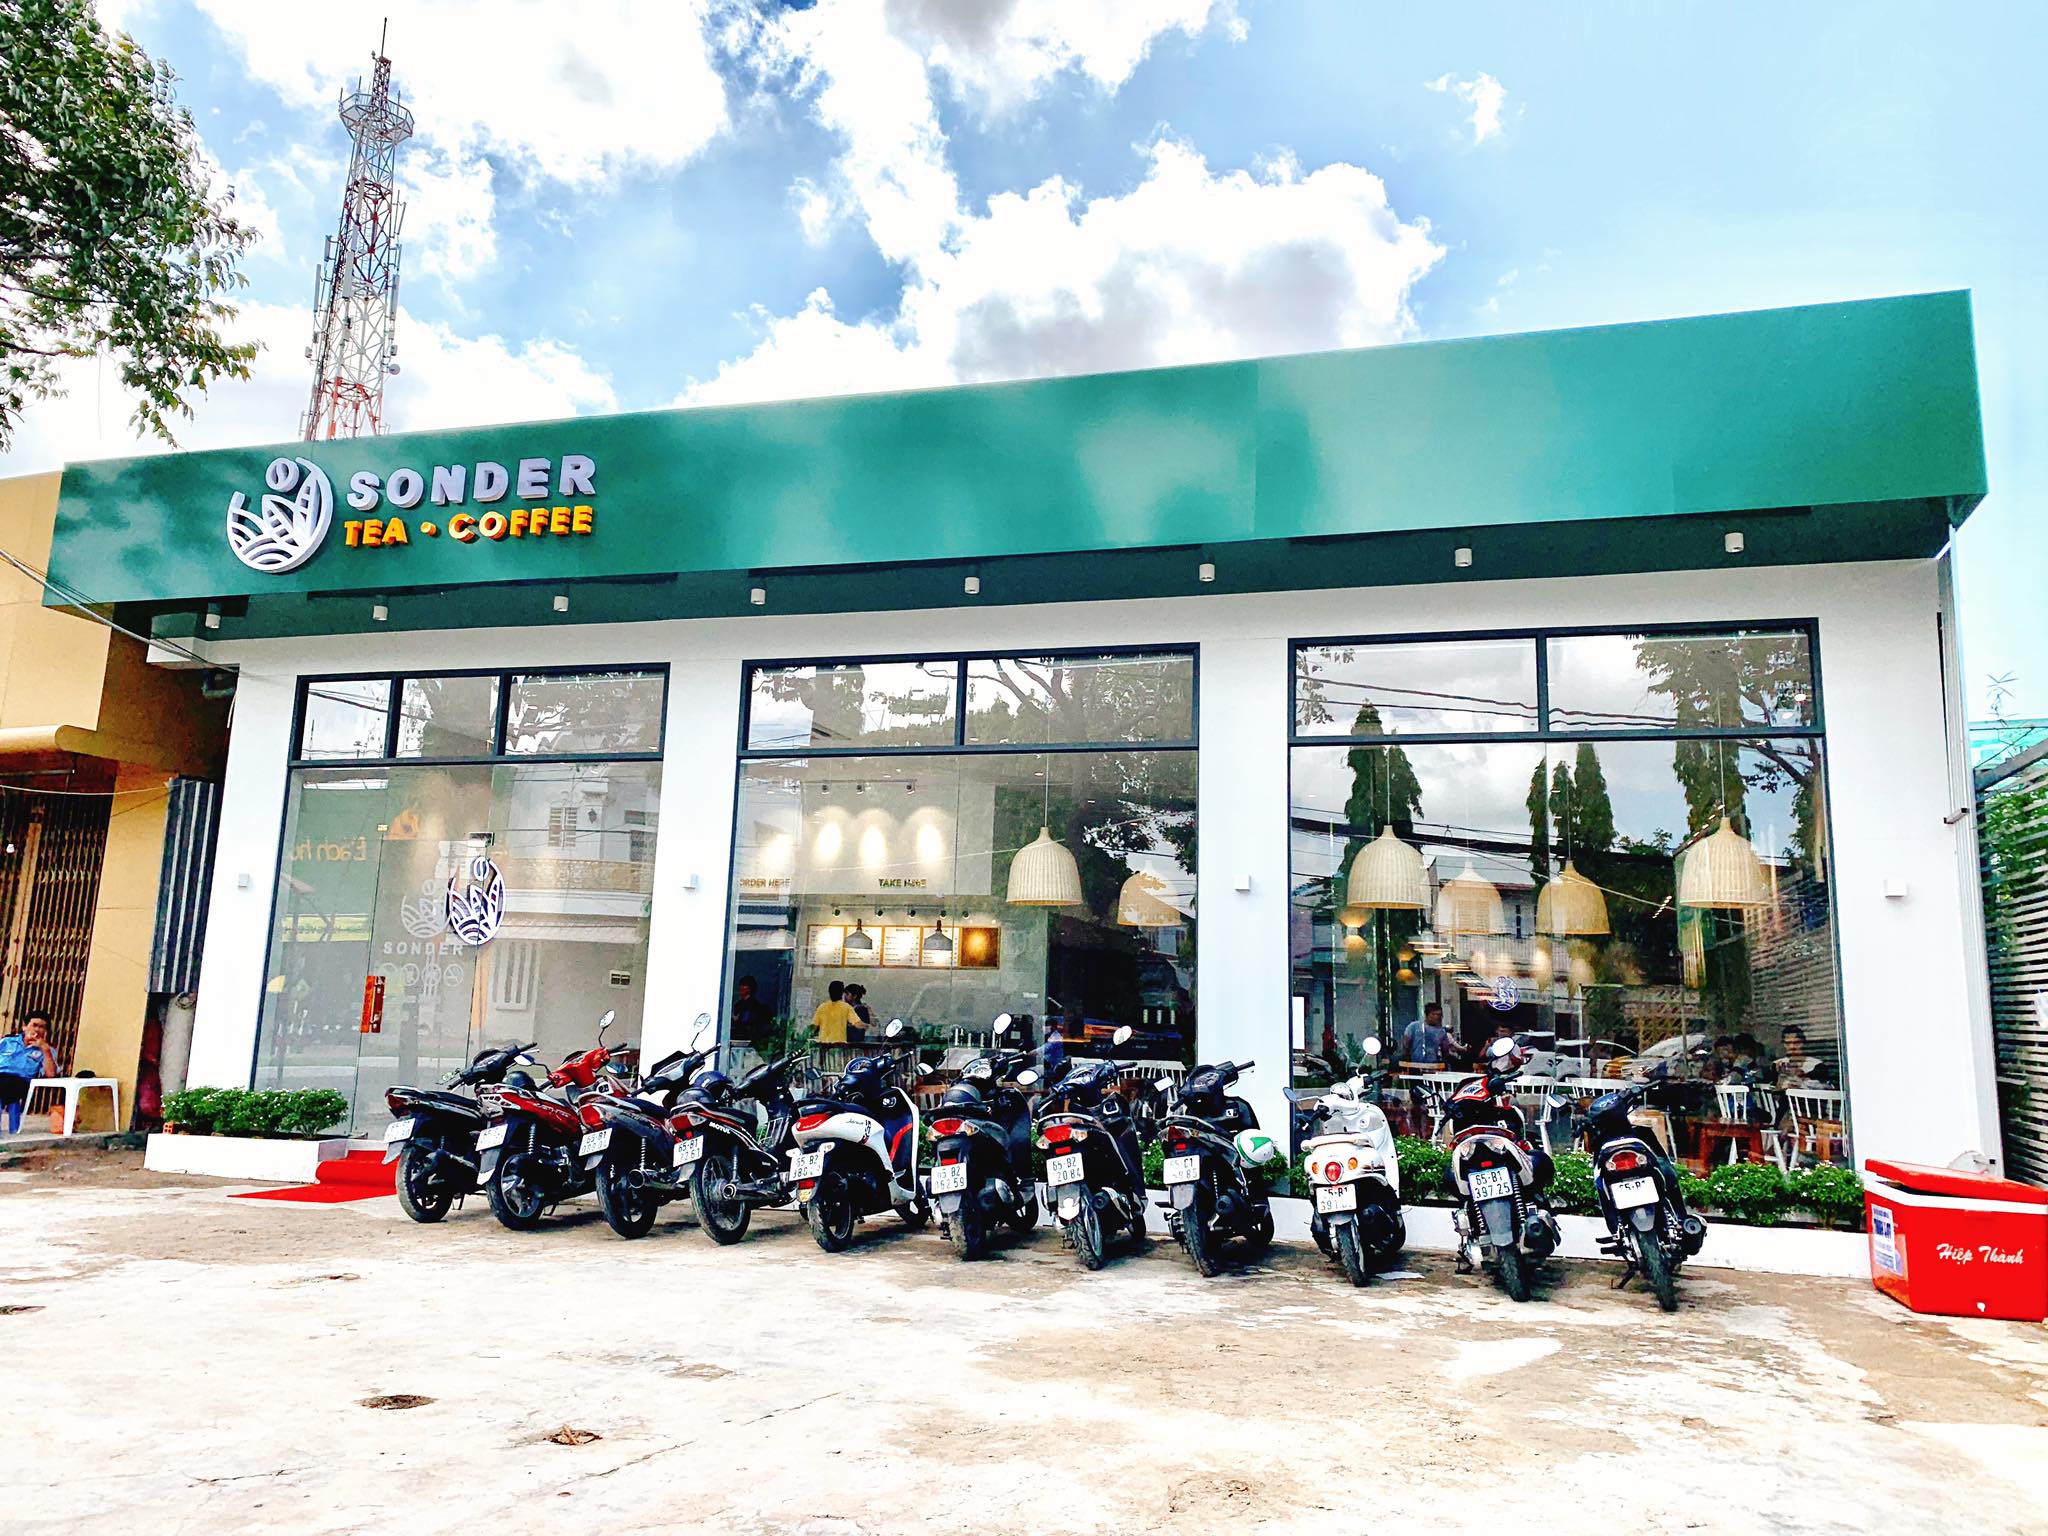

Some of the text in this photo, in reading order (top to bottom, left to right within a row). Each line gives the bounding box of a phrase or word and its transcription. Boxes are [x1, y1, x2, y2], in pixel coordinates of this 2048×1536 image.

[347, 454, 596, 511] SONDER
[344, 505, 593, 547] TEA COFFEE
[878, 878, 902, 888] TAKE
[383, 941, 464, 956] SONDER
[1475, 1170, 1503, 1185] 65-B1
[1936, 1243, 2024, 1265] Hiệp Thành
